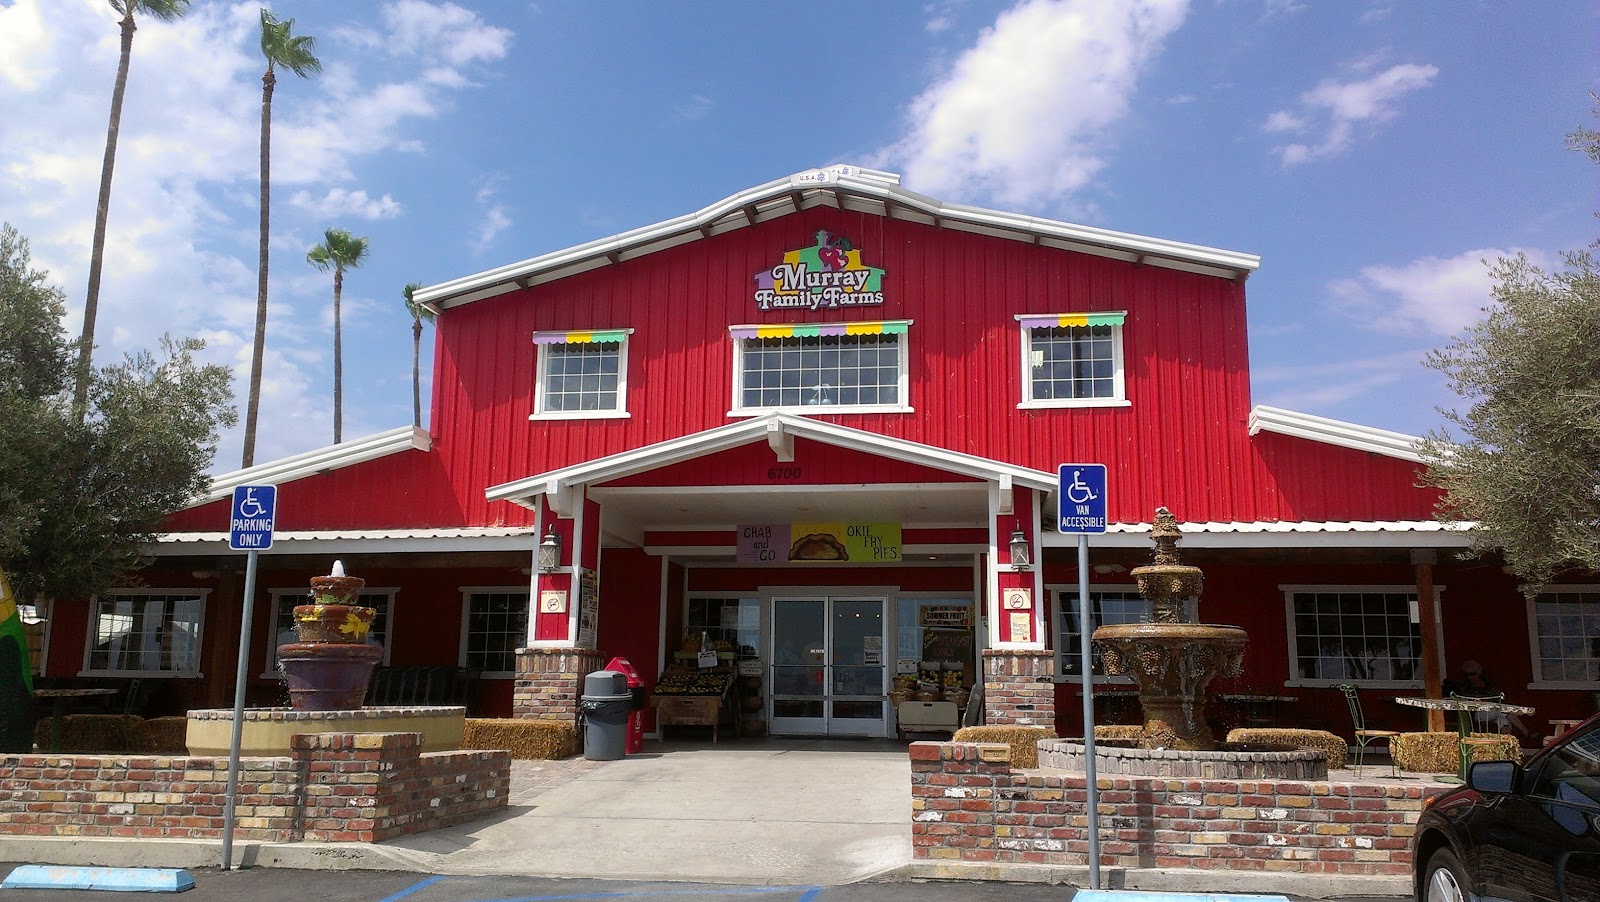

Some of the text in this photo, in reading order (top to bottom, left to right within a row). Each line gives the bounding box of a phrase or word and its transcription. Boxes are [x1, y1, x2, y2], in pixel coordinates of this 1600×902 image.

[772, 263, 870, 290] Murray
[755, 287, 884, 310] Family Farms
[768, 468, 801, 479] 6700
[1076, 505, 1090, 515] VAN
[233, 519, 271, 532] PARKING
[1062, 516, 1104, 528] ACCESSIBLE
[743, 527, 772, 539] GRAB
[847, 525, 872, 537] OKIE
[240, 533, 263, 546] ONLY
[753, 538, 769, 549] and
[864, 536, 883, 548] FRY
[759, 550, 776, 561] GO
[873, 547, 897, 560] PIES
[926, 612, 965, 620] SUMMER FRUIT
